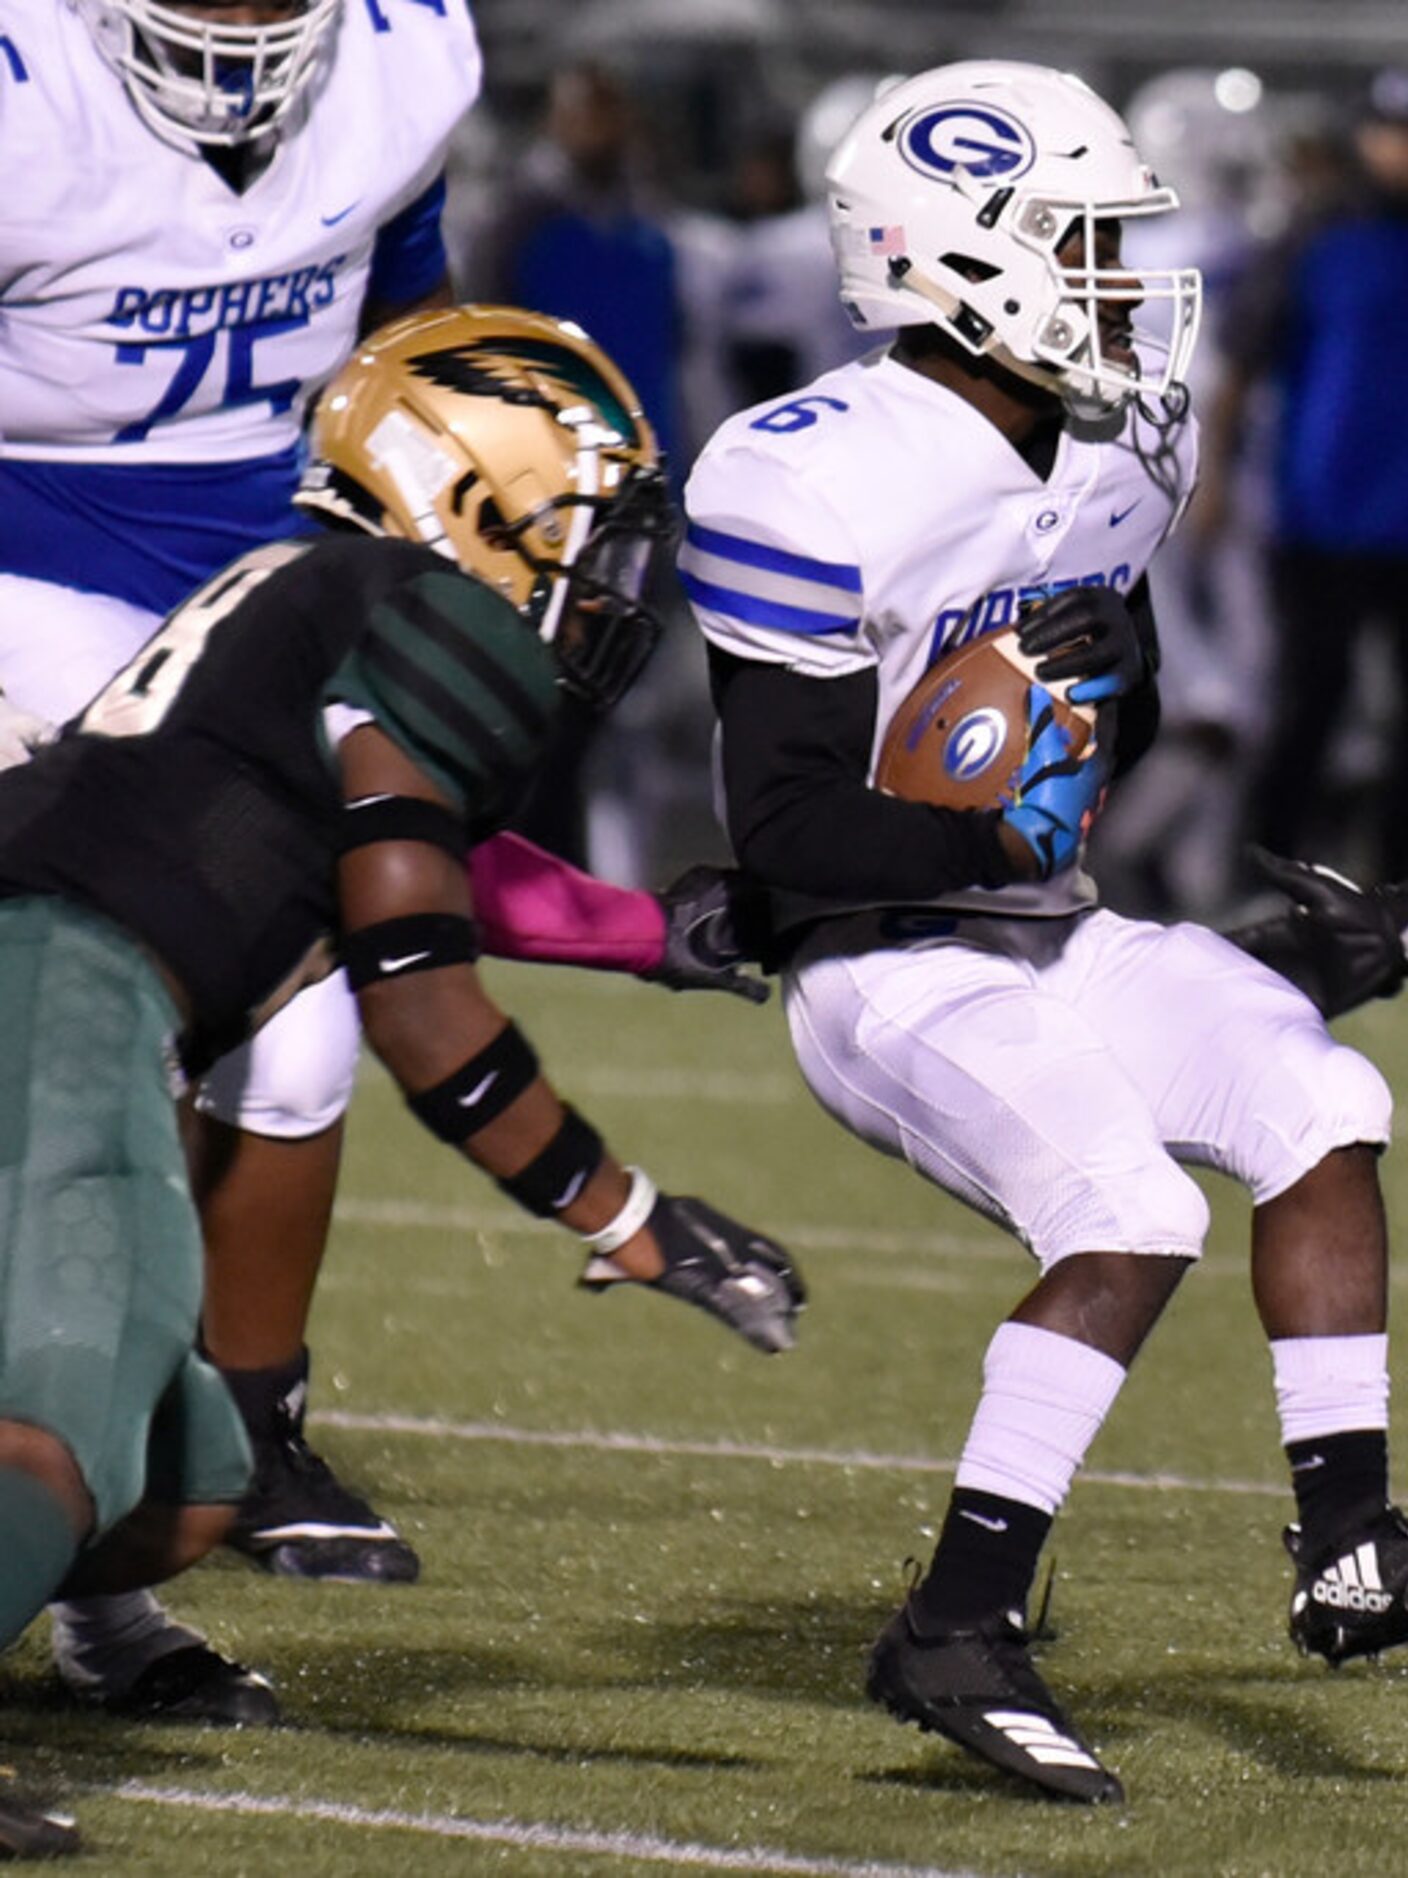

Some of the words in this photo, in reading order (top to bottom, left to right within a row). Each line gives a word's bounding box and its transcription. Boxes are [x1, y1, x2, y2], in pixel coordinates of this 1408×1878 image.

[908, 107, 1022, 177] G
[111, 319, 309, 442] 75
[749, 395, 849, 433] 6
[1312, 1580, 1394, 1614] adidas
